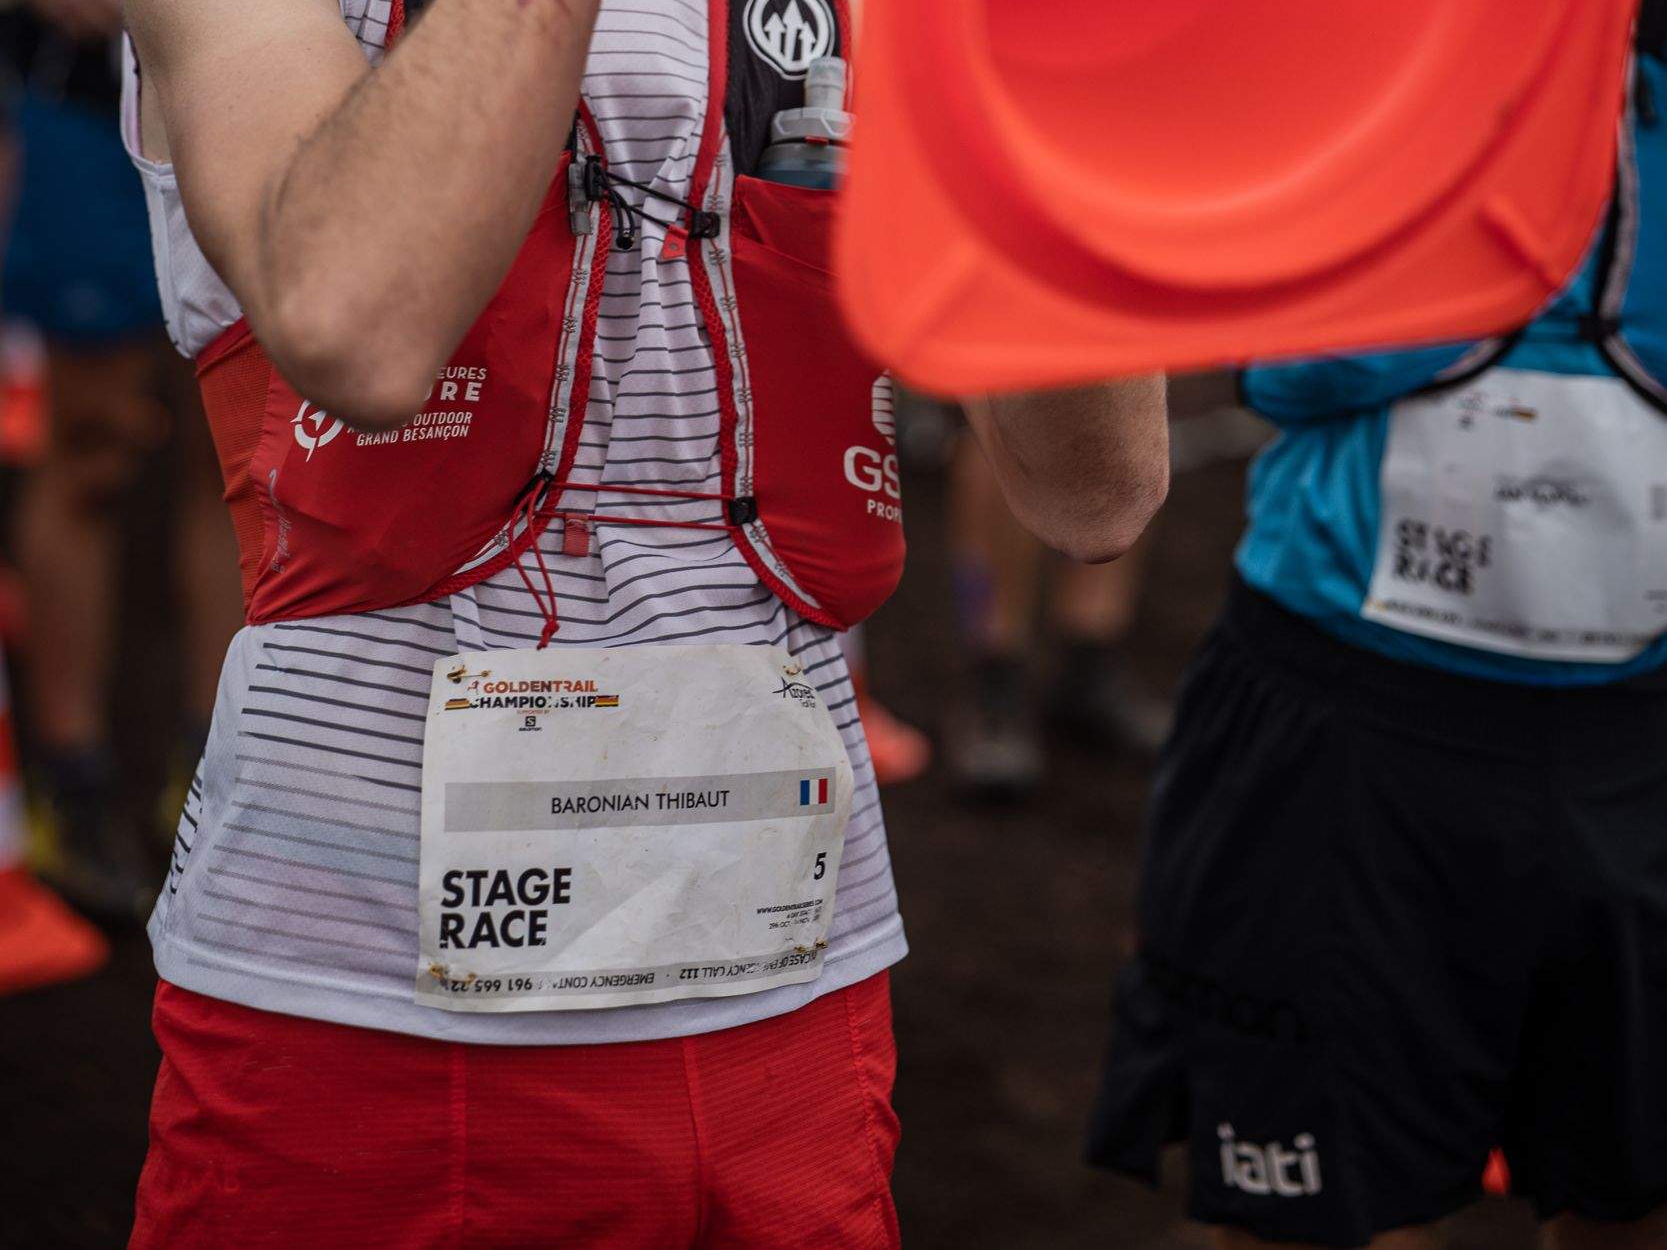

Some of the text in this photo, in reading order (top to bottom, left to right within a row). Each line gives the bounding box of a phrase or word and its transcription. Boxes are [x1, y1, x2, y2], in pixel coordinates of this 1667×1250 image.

[437, 366, 488, 380] EURES
[413, 412, 473, 427] OUTDOOR
[356, 430, 399, 447] GRAND
[403, 425, 470, 442] BESANÇON
[843, 445, 900, 499] GS
[483, 679, 598, 694] GOLDENTRAIL
[551, 790, 730, 814] BARONIAN THIBAUT
[814, 852, 828, 880] 5
[440, 868, 572, 908] STAGE
[439, 909, 549, 949] RACE
[788, 952, 811, 966] CASE
[679, 968, 700, 979] 112
[702, 966, 725, 978] CALL
[474, 979, 502, 992] 665
[507, 978, 533, 991] 961
[590, 972, 655, 988] EMERGENCY
[1217, 1120, 1322, 1197] iati
